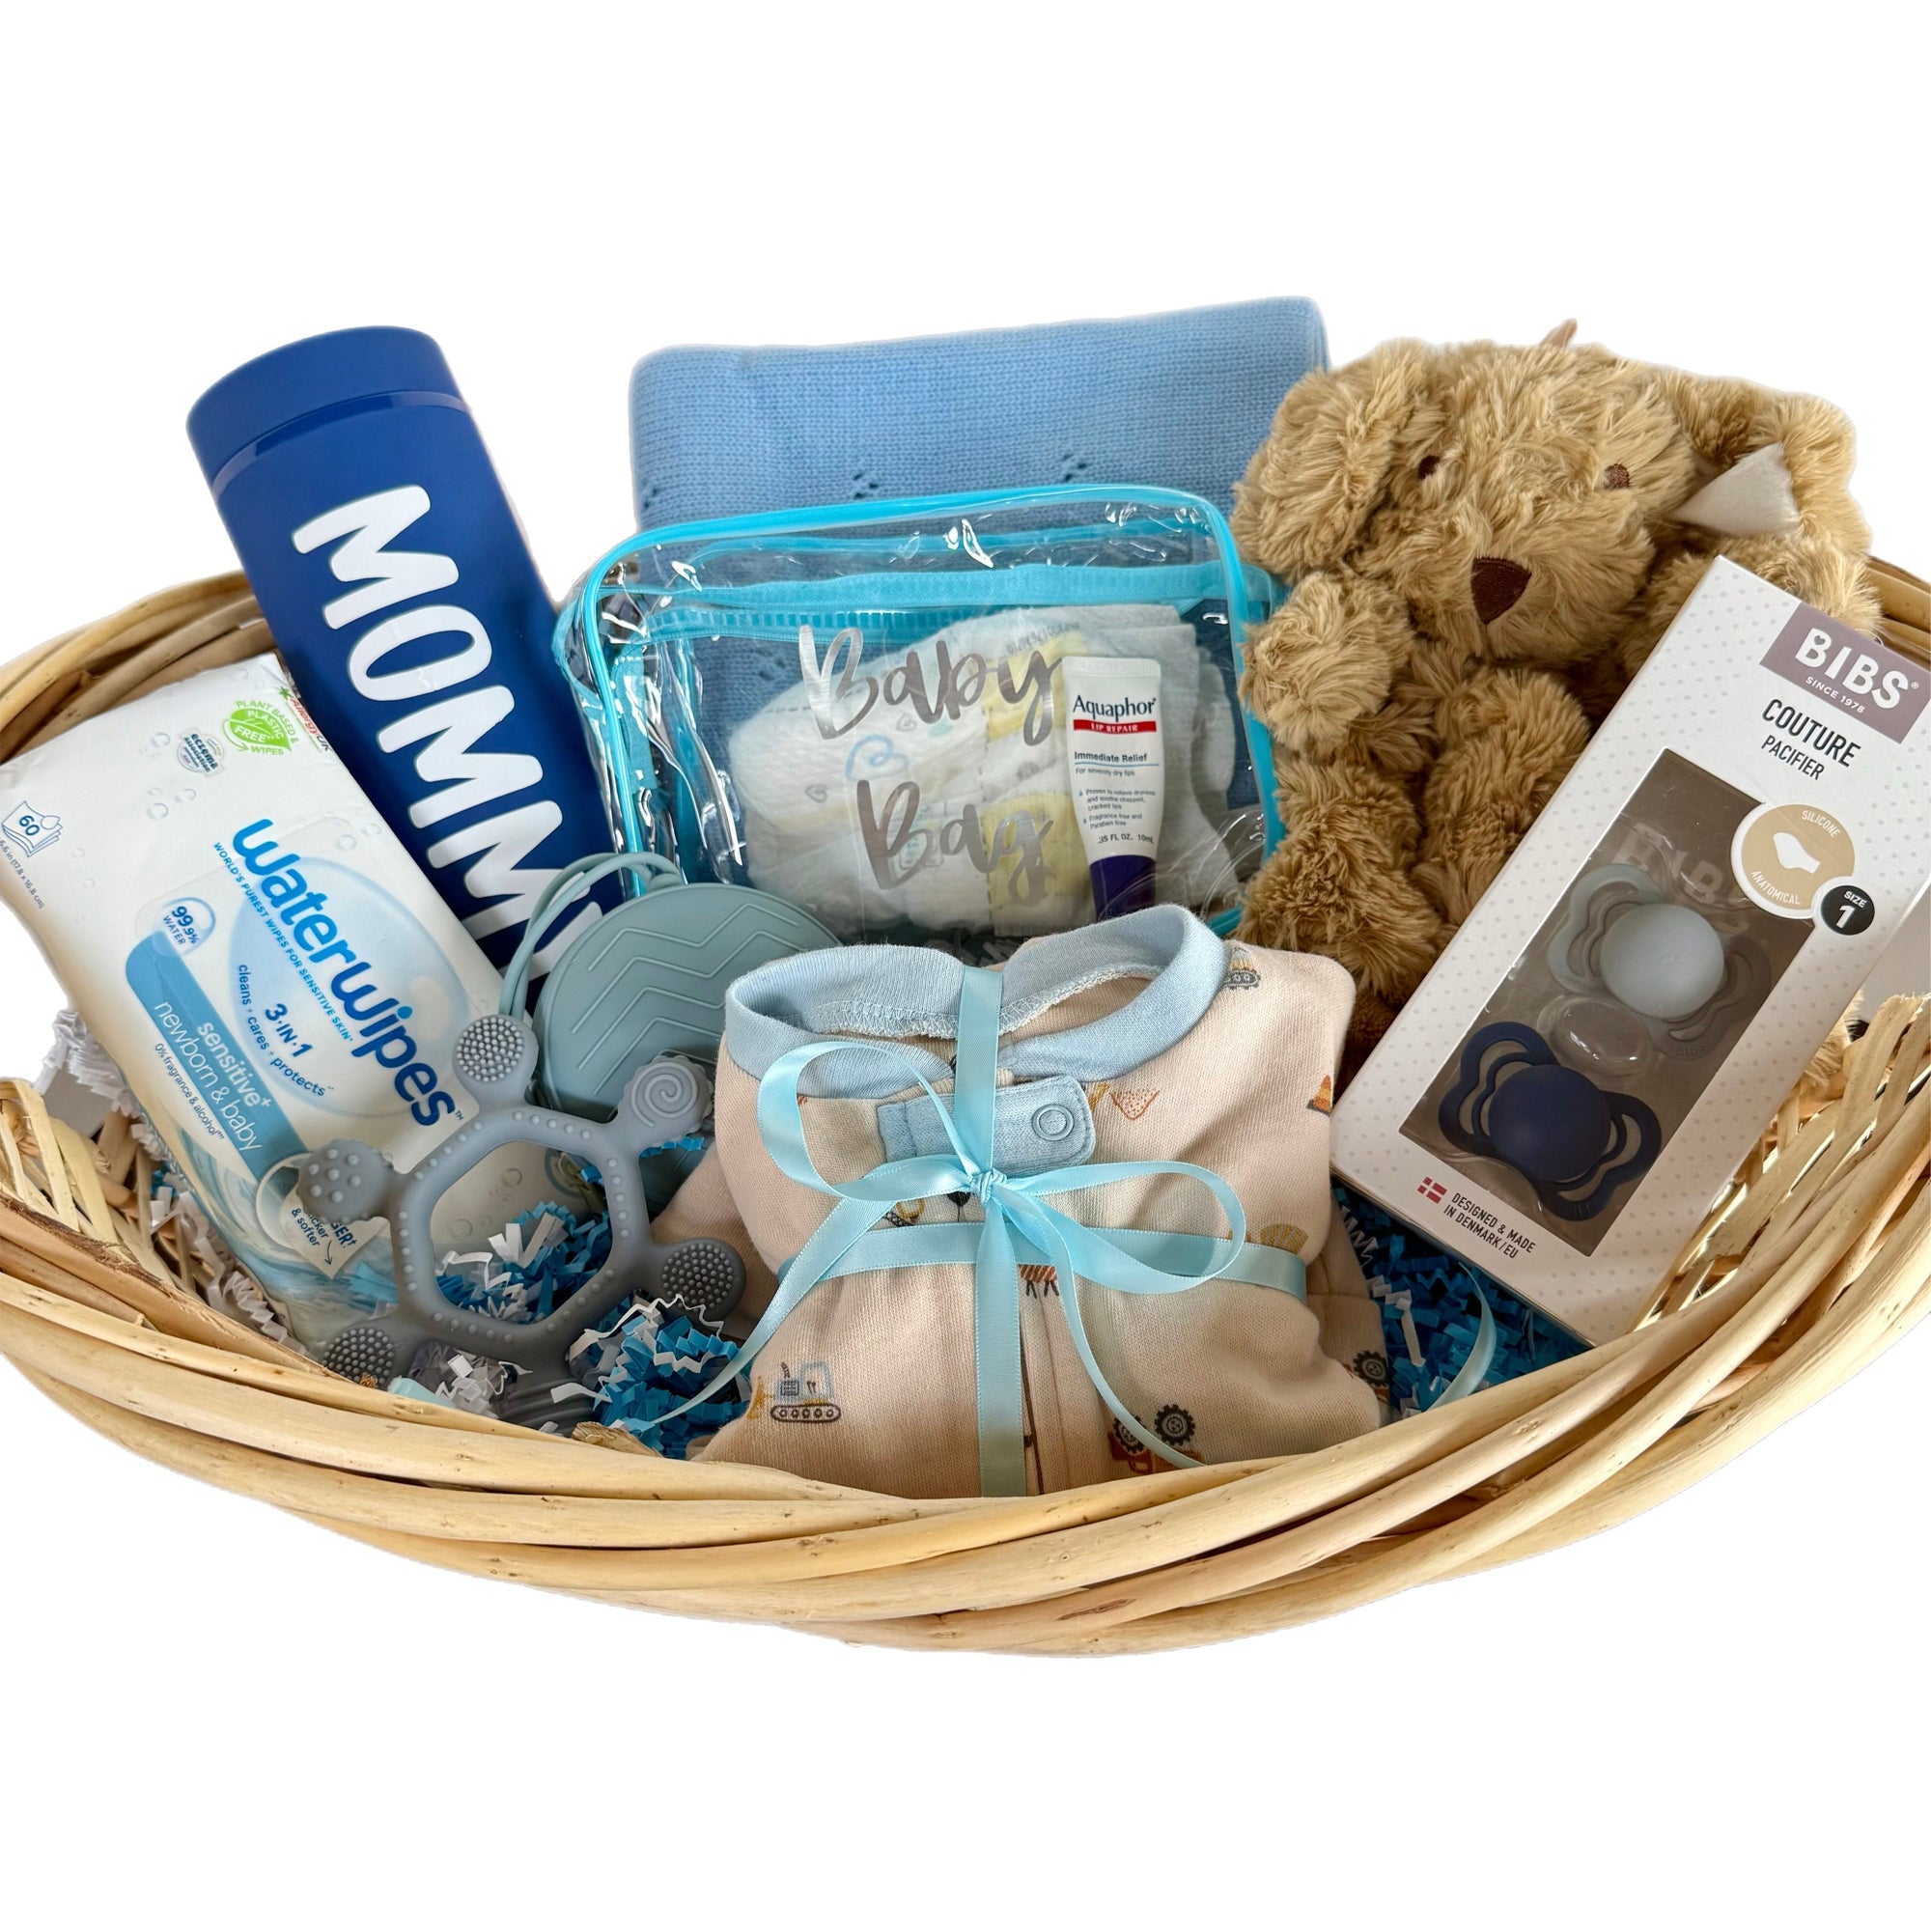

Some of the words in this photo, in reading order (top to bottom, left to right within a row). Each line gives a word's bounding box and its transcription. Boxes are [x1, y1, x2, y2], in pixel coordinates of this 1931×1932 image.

[798, 625, 1062, 746] Baby
[1805, 676, 1839, 699] SINCE
[1840, 695, 1866, 714] 1978
[236, 700, 273, 711] PLANT
[271, 708, 296, 736] BASED
[247, 710, 285, 740] PLASTIC
[1090, 722, 1105, 731] LIP
[1106, 724, 1138, 733] REPAIR
[1762, 699, 1861, 768] COUTURE
[190, 733, 218, 770] eczema
[251, 745, 284, 755] WIPES
[1075, 751, 1120, 762] Immediate
[1122, 753, 1147, 763] Relief
[1760, 735, 1826, 781] PACIFIER
[19, 815, 40, 836] 60
[1802, 809, 1840, 838] SILICONE
[857, 780, 1053, 906] Bag
[1751, 870, 1802, 905] ANATOMICAL
[1843, 890, 1868, 909] SIZE
[163, 915, 186, 944] WATER
[172, 906, 200, 943] 99.9%
[213, 842, 244, 882] WORLD'S
[241, 883, 269, 918] PUREST
[266, 918, 289, 948] WIPES
[285, 948, 303, 968] FOR
[299, 968, 333, 1017] SENSITIVE
[1835, 905, 1856, 929] 1
[238, 965, 252, 1006] cleans
[247, 1017, 269, 1050] cares
[154, 1043, 168, 1058] 0%
[163, 1054, 192, 1097] fragrance
[189, 1096, 200, 1106] &
[154, 1001, 218, 1088] newborn
[210, 1086, 230, 1104] &
[220, 1099, 263, 1151] baby
[292, 1208, 301, 1218] &
[306, 1214, 329, 1239] icker
[1443, 1204, 1457, 1218] IN
[1451, 1192, 1498, 1228] DESIGNED
[1497, 1223, 1506, 1235] &
[1506, 1228, 1536, 1253] MADE
[296, 1217, 321, 1246] softer
